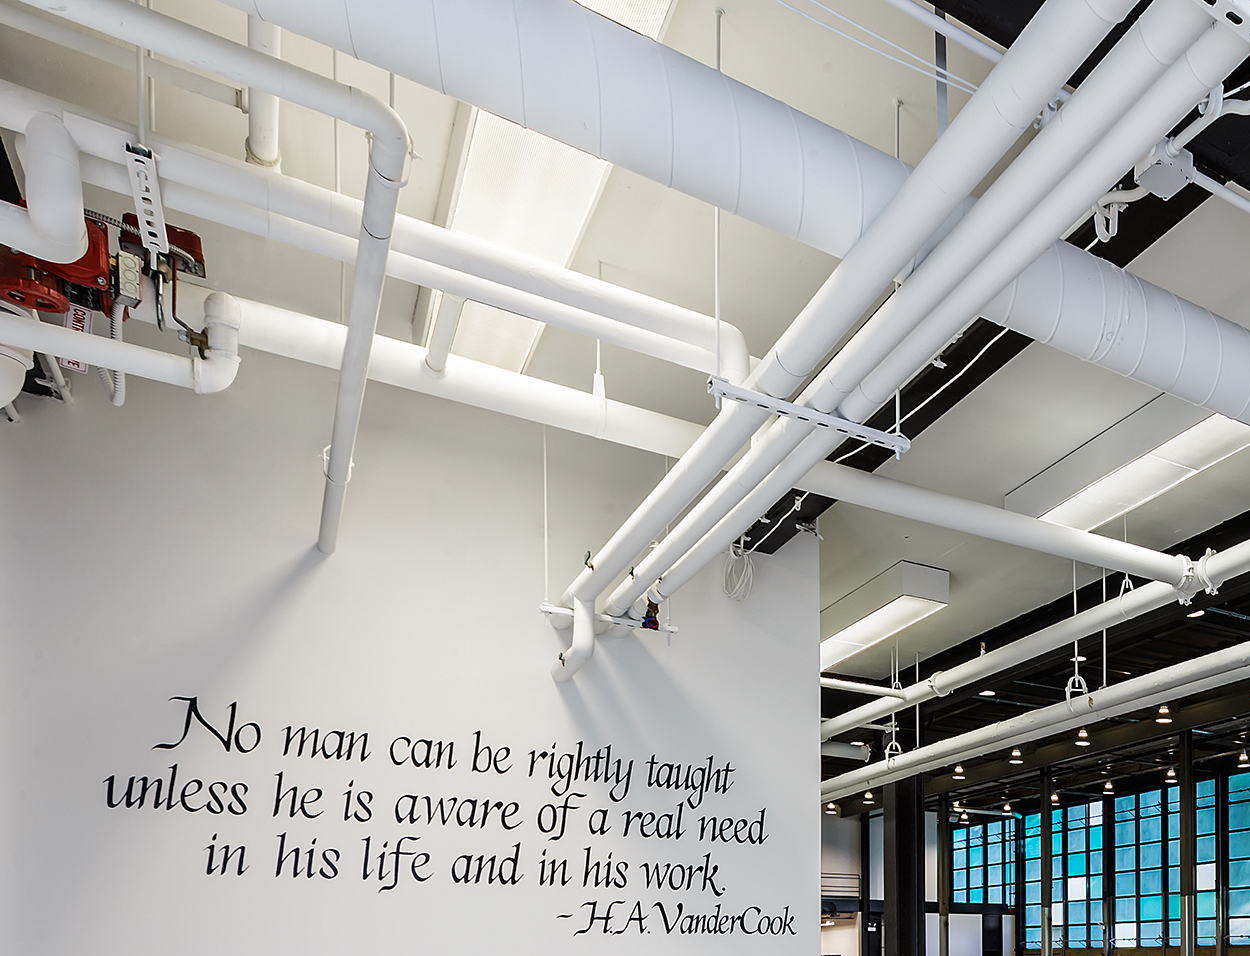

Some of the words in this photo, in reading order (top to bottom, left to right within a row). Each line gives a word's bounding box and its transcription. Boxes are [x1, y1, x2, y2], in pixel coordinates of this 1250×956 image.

[72, 308, 86, 332] CONTR
[151, 696, 262, 754] No
[282, 725, 372, 762] man
[389, 736, 457, 770] can
[471, 730, 512, 775] be
[528, 740, 634, 803] rightly
[645, 755, 736, 810] taught
[102, 763, 249, 816] unless
[272, 771, 323, 819] he
[343, 779, 373, 823] is
[394, 794, 524, 831] aware
[537, 792, 587, 841] of
[588, 809, 612, 836] a
[621, 801, 685, 840] real
[697, 807, 769, 845] need
[206, 833, 247, 876] in
[275, 832, 340, 880] his
[361, 835, 432, 893] life
[451, 842, 524, 885] and
[539, 848, 571, 887] in
[582, 846, 629, 889] his
[639, 852, 726, 897] work.
